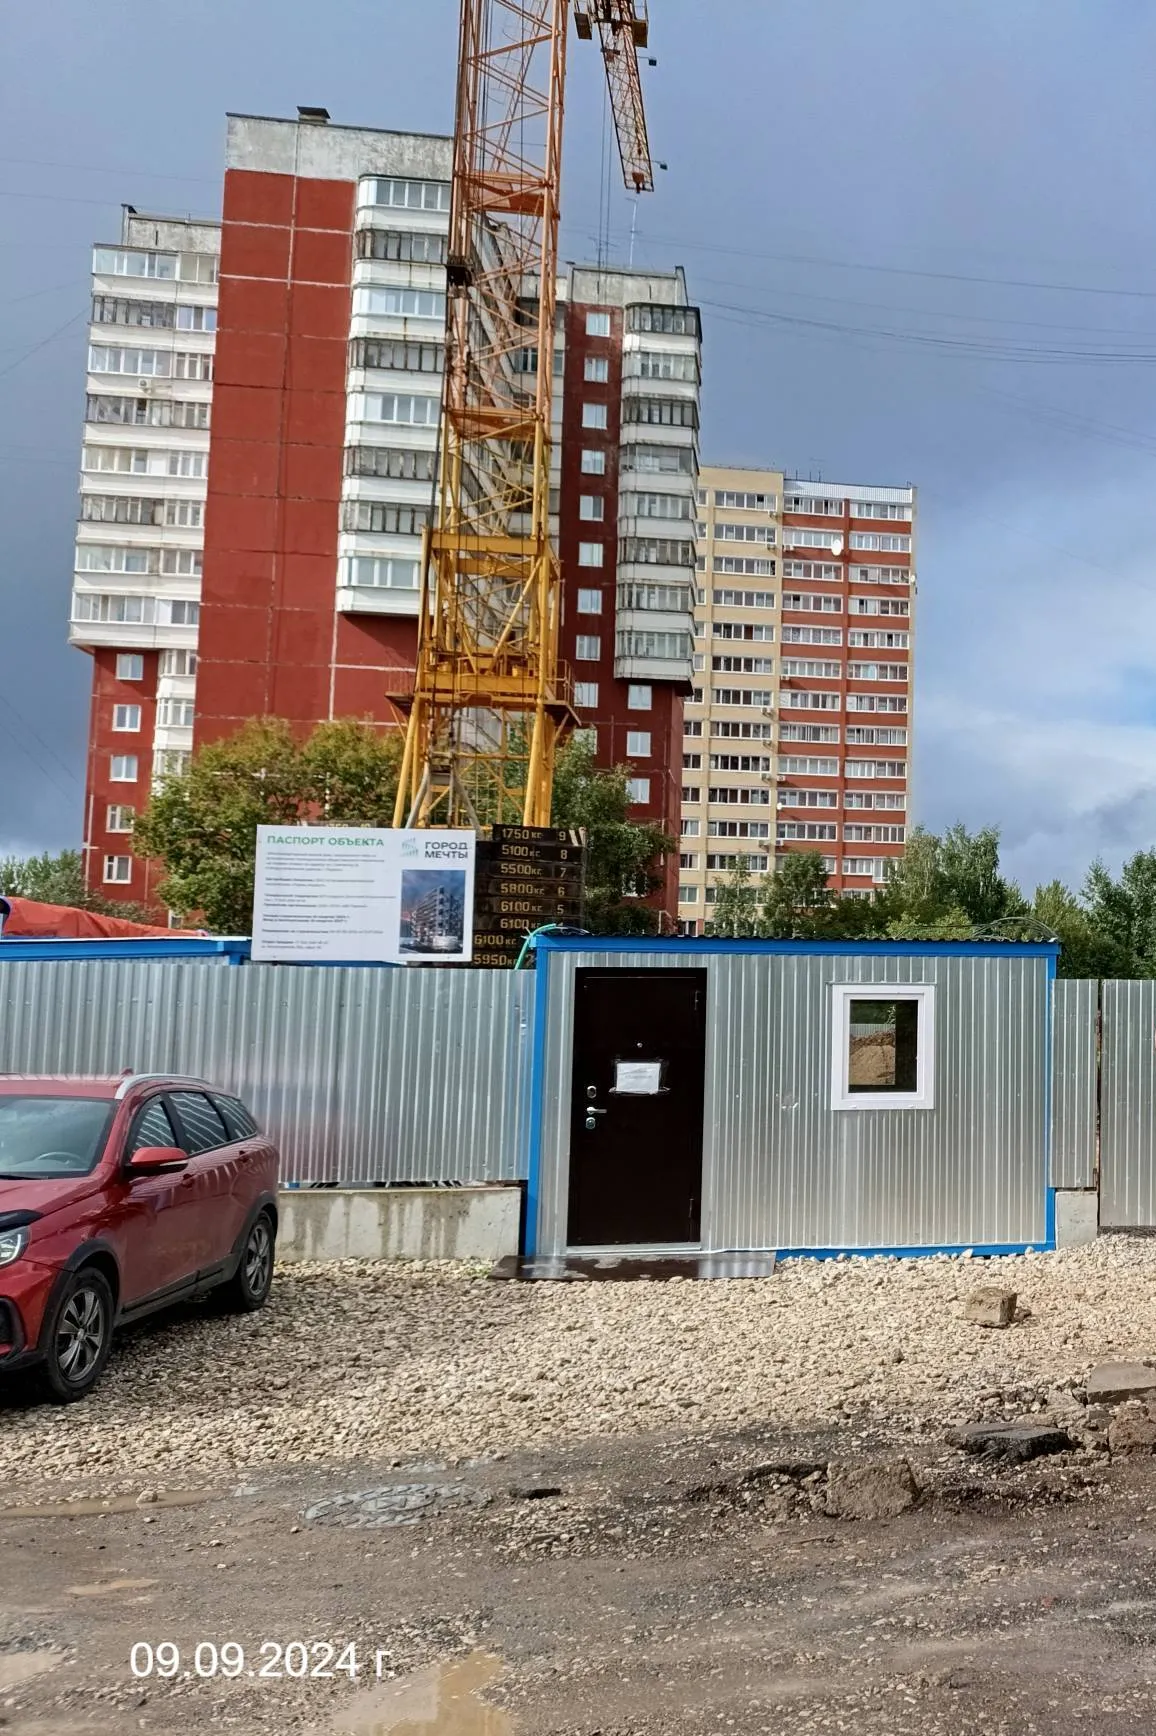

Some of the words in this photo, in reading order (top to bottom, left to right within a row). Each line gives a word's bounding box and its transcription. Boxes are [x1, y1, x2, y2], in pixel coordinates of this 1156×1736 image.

[502, 828, 530, 840] 1750
[558, 831, 566, 841] 9
[267, 835, 326, 846] ПАСПОРТ
[328, 837, 385, 847] ОБЪЕКТА
[425, 841, 468, 850] ГОРОД
[424, 850, 468, 859] МЕЧТЫ
[502, 844, 529, 856] 5100
[560, 849, 568, 860] 8
[560, 867, 567, 878] 7
[501, 883, 534, 894] 5800
[557, 886, 565, 897] 6
[501, 901, 530, 912] 6100
[557, 904, 564, 915] 5
[500, 918, 530, 929] 6100
[474, 934, 504, 945] 6100
[474, 953, 507, 966] 5950
